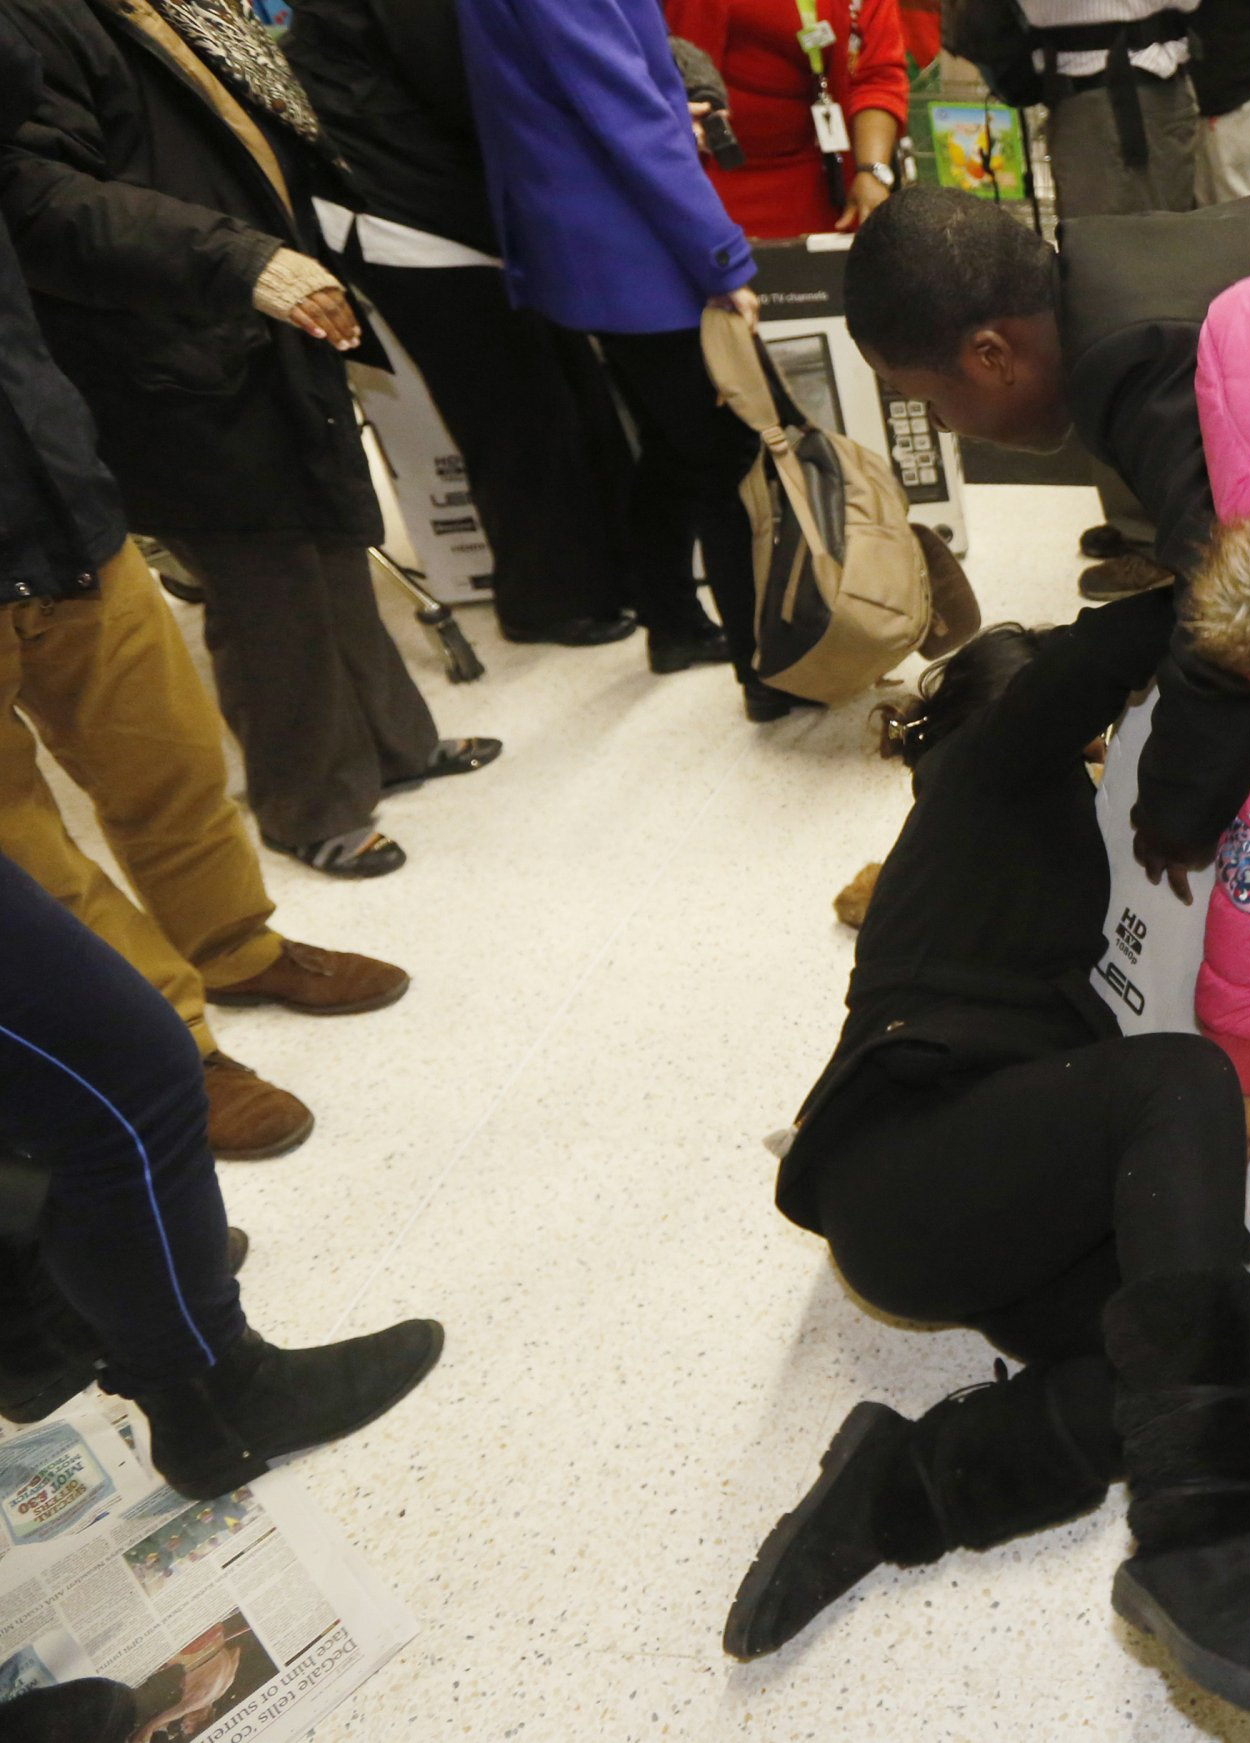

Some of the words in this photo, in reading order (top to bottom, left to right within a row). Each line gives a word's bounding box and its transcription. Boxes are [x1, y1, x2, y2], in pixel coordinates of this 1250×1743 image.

[1121, 906, 1147, 940] HD
[1115, 938, 1138, 965] 1080p
[51, 1461, 84, 1494] MOT
[315, 1626, 350, 1659] face
[280, 1656, 317, 1687] him
[298, 1637, 359, 1692] DeGale
[257, 1690, 297, 1724] tells
[260, 1684, 280, 1705] or
